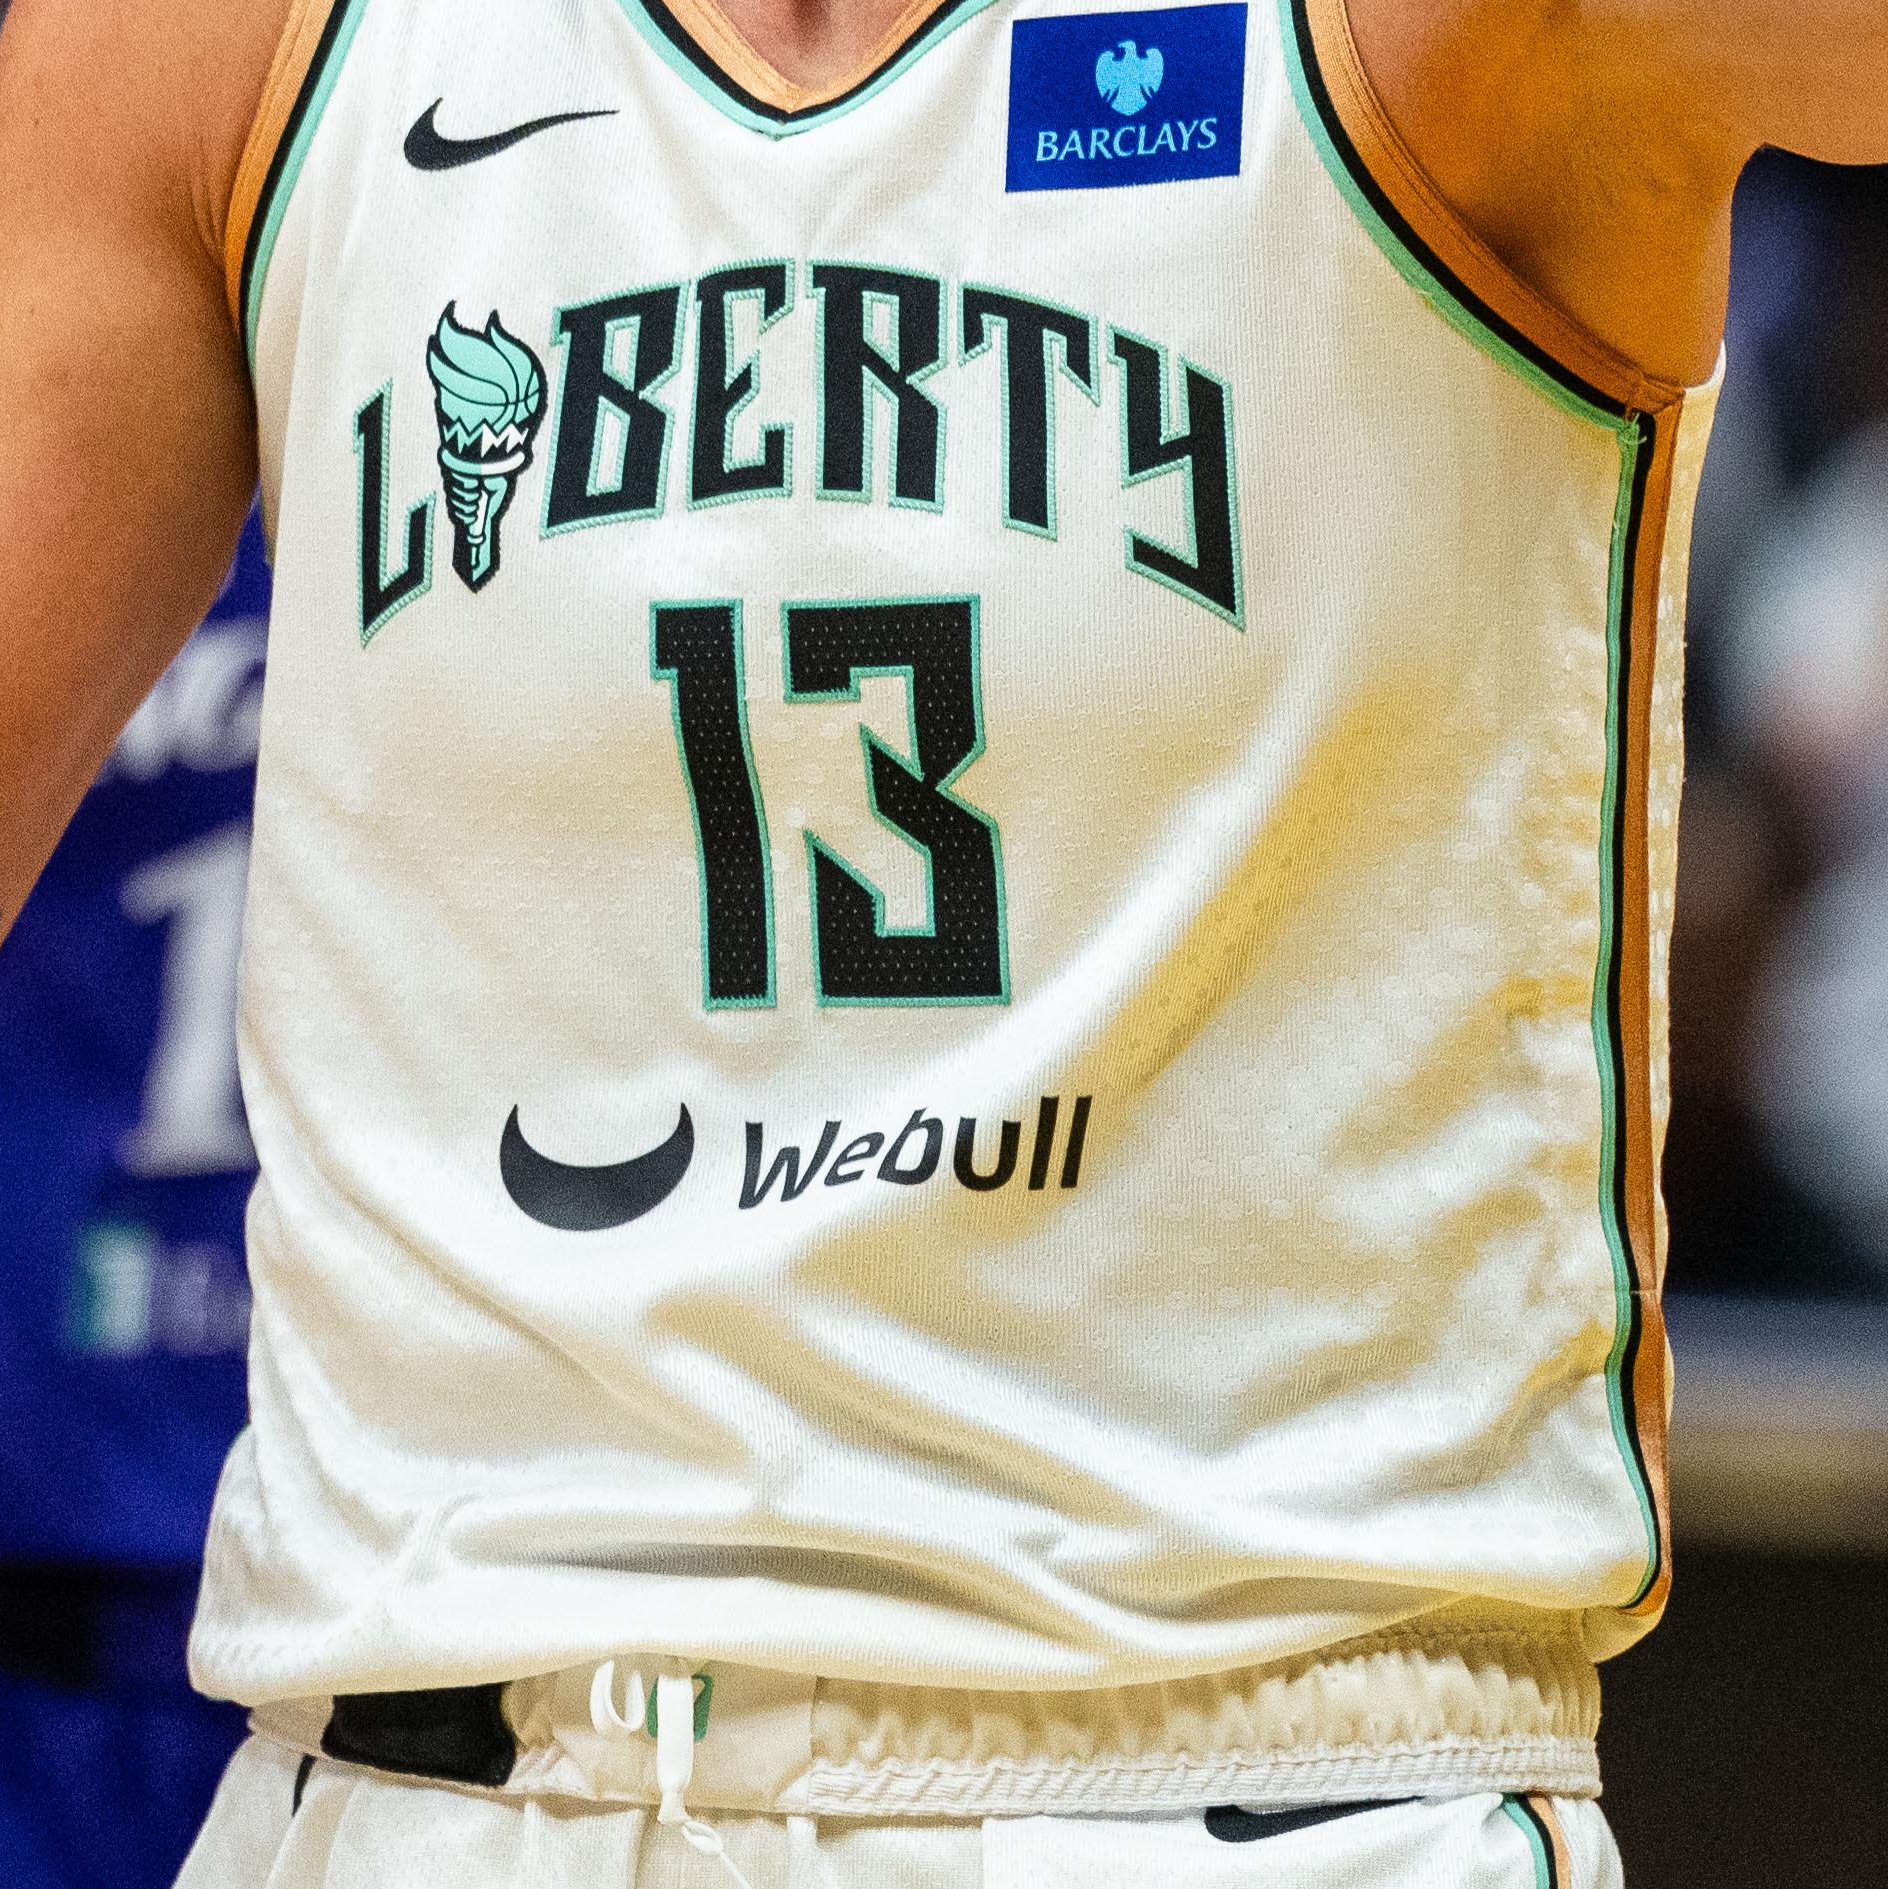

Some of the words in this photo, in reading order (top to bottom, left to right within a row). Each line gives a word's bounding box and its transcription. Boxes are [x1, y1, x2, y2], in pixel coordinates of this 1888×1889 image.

[1036, 118, 1217, 162] BARCLAYS
[649, 595, 1011, 1010] 13
[738, 1095, 1093, 1210] Webull
